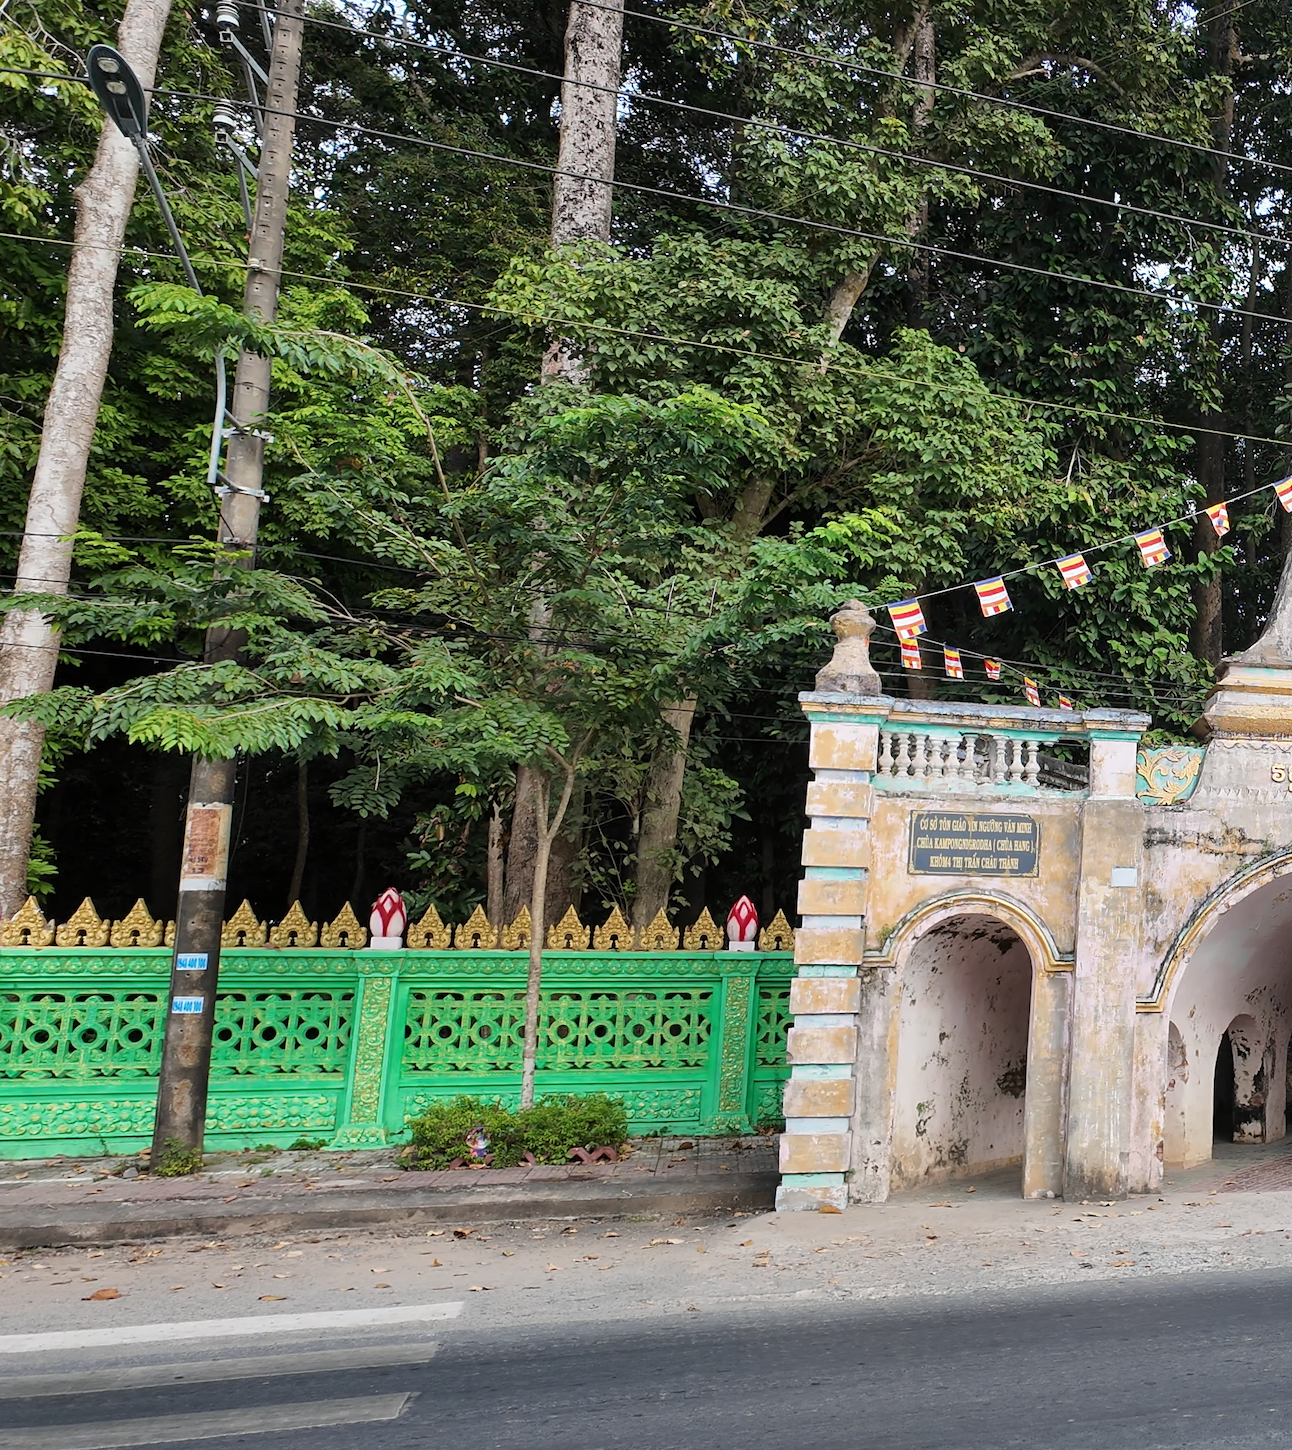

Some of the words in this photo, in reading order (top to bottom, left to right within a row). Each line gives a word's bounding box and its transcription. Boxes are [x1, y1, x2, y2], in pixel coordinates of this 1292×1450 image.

[929, 815, 938, 831] SỞ
[939, 817, 951, 831] TÔN
[952, 817, 967, 832] GIÁO
[978, 818, 1003, 833] NGƯỠNG
[1016, 822, 1033, 834] MINH
[916, 835, 933, 849] CHÙA
[997, 837, 1014, 851] CHÙA
[1014, 840, 1030, 852] HANG
[952, 856, 964, 871] THỊ
[964, 852, 981, 869] TRẤN
[981, 854, 998, 869] CHÂU
[998, 855, 1020, 870] THÀNH
